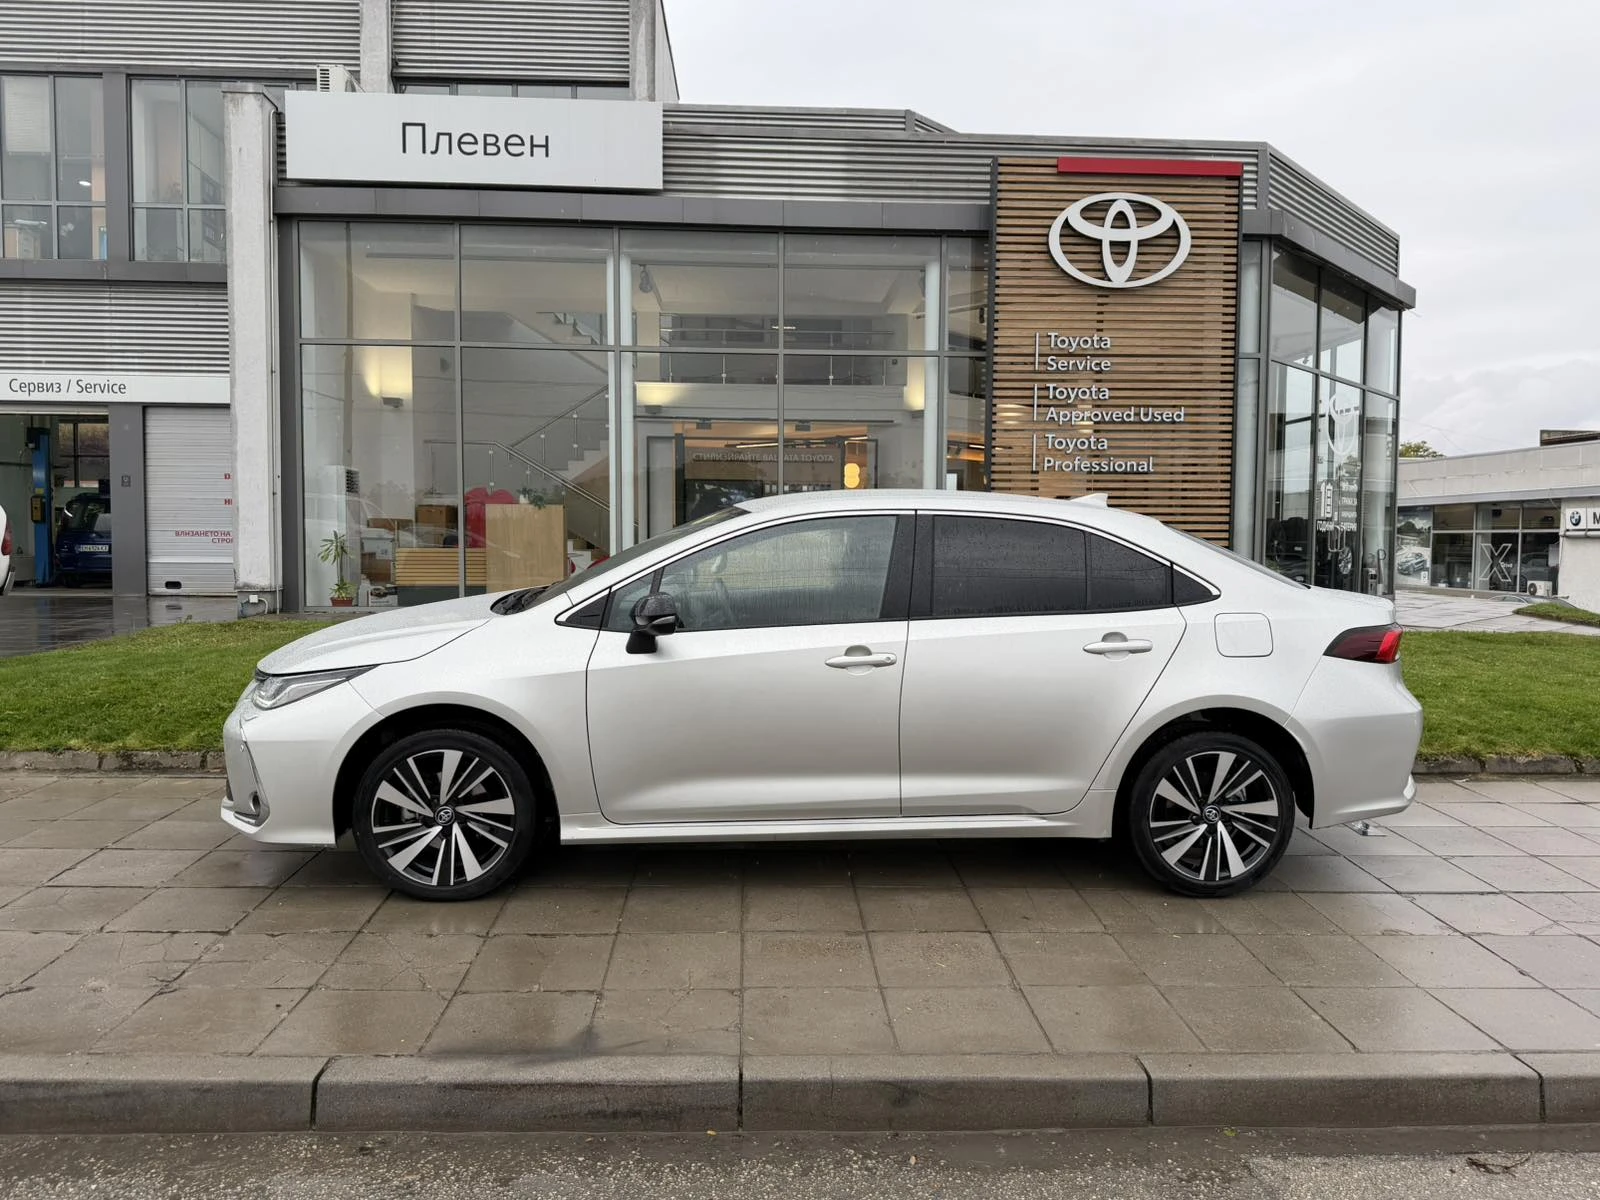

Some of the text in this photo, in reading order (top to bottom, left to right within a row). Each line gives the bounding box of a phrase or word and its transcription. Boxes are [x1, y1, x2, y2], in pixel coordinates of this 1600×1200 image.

[402, 122, 549, 158] Плевен
[1048, 332, 1111, 352] Toyota
[1047, 356, 1111, 371] Service
[9, 378, 127, 396] Сервиз / Service
[1047, 383, 1110, 403] Toyota
[1046, 407, 1185, 425] Approved Used
[1045, 434, 1108, 454] Toyota
[801, 455, 834, 463] TOYOTA
[1043, 457, 1154, 473] Professional
